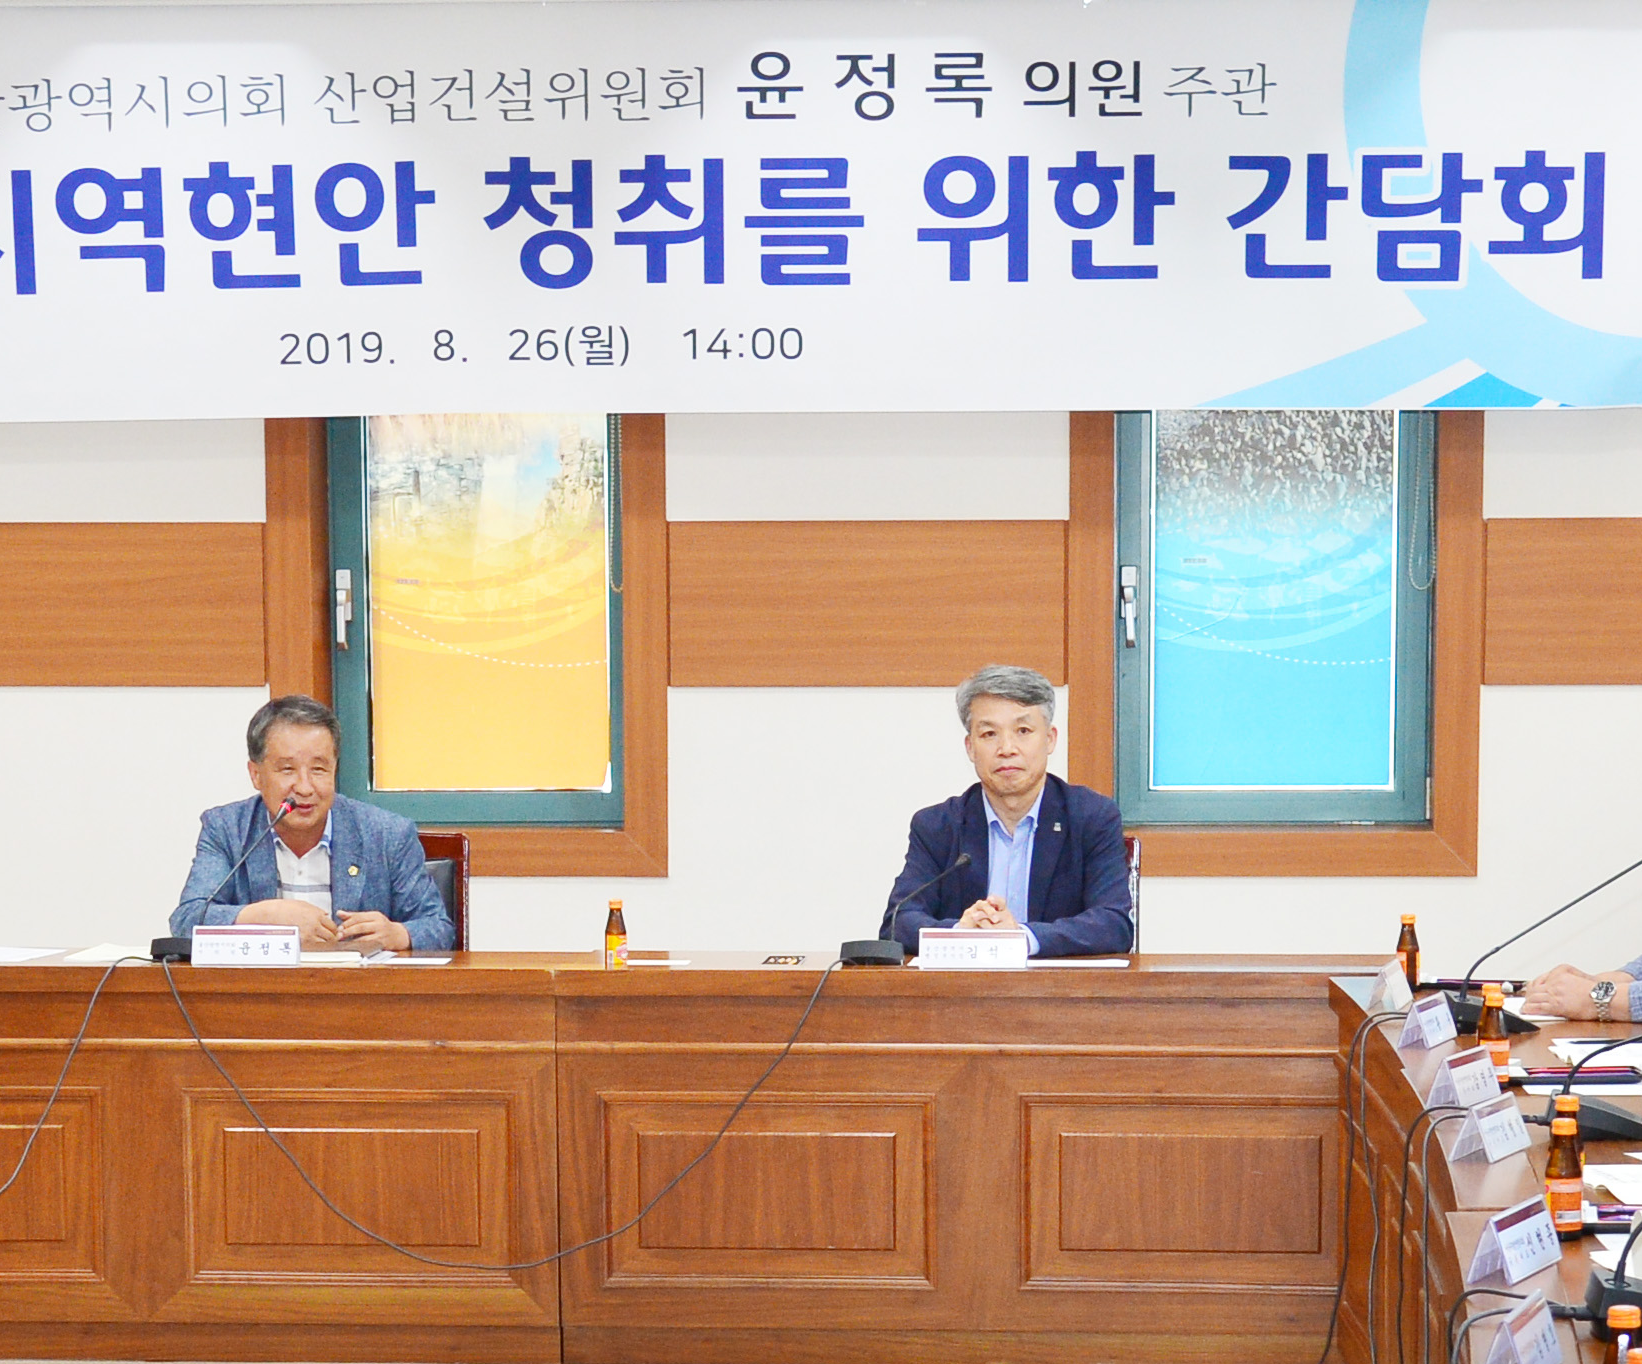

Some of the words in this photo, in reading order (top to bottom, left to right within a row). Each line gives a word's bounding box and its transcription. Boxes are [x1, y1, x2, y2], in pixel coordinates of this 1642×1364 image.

[315, 65, 704, 126] 산업건설위원회
[1023, 59, 1143, 118] 의원
[1163, 62, 1278, 118] 주관
[483, 154, 864, 290] 청취를
[917, 150, 1176, 283] 위한
[1226, 150, 1606, 282] 간담회
[280, 331, 395, 365] 2019.
[433, 329, 468, 363] 8.
[508, 325, 630, 367] 26(월)
[683, 327, 803, 360] 14:00
